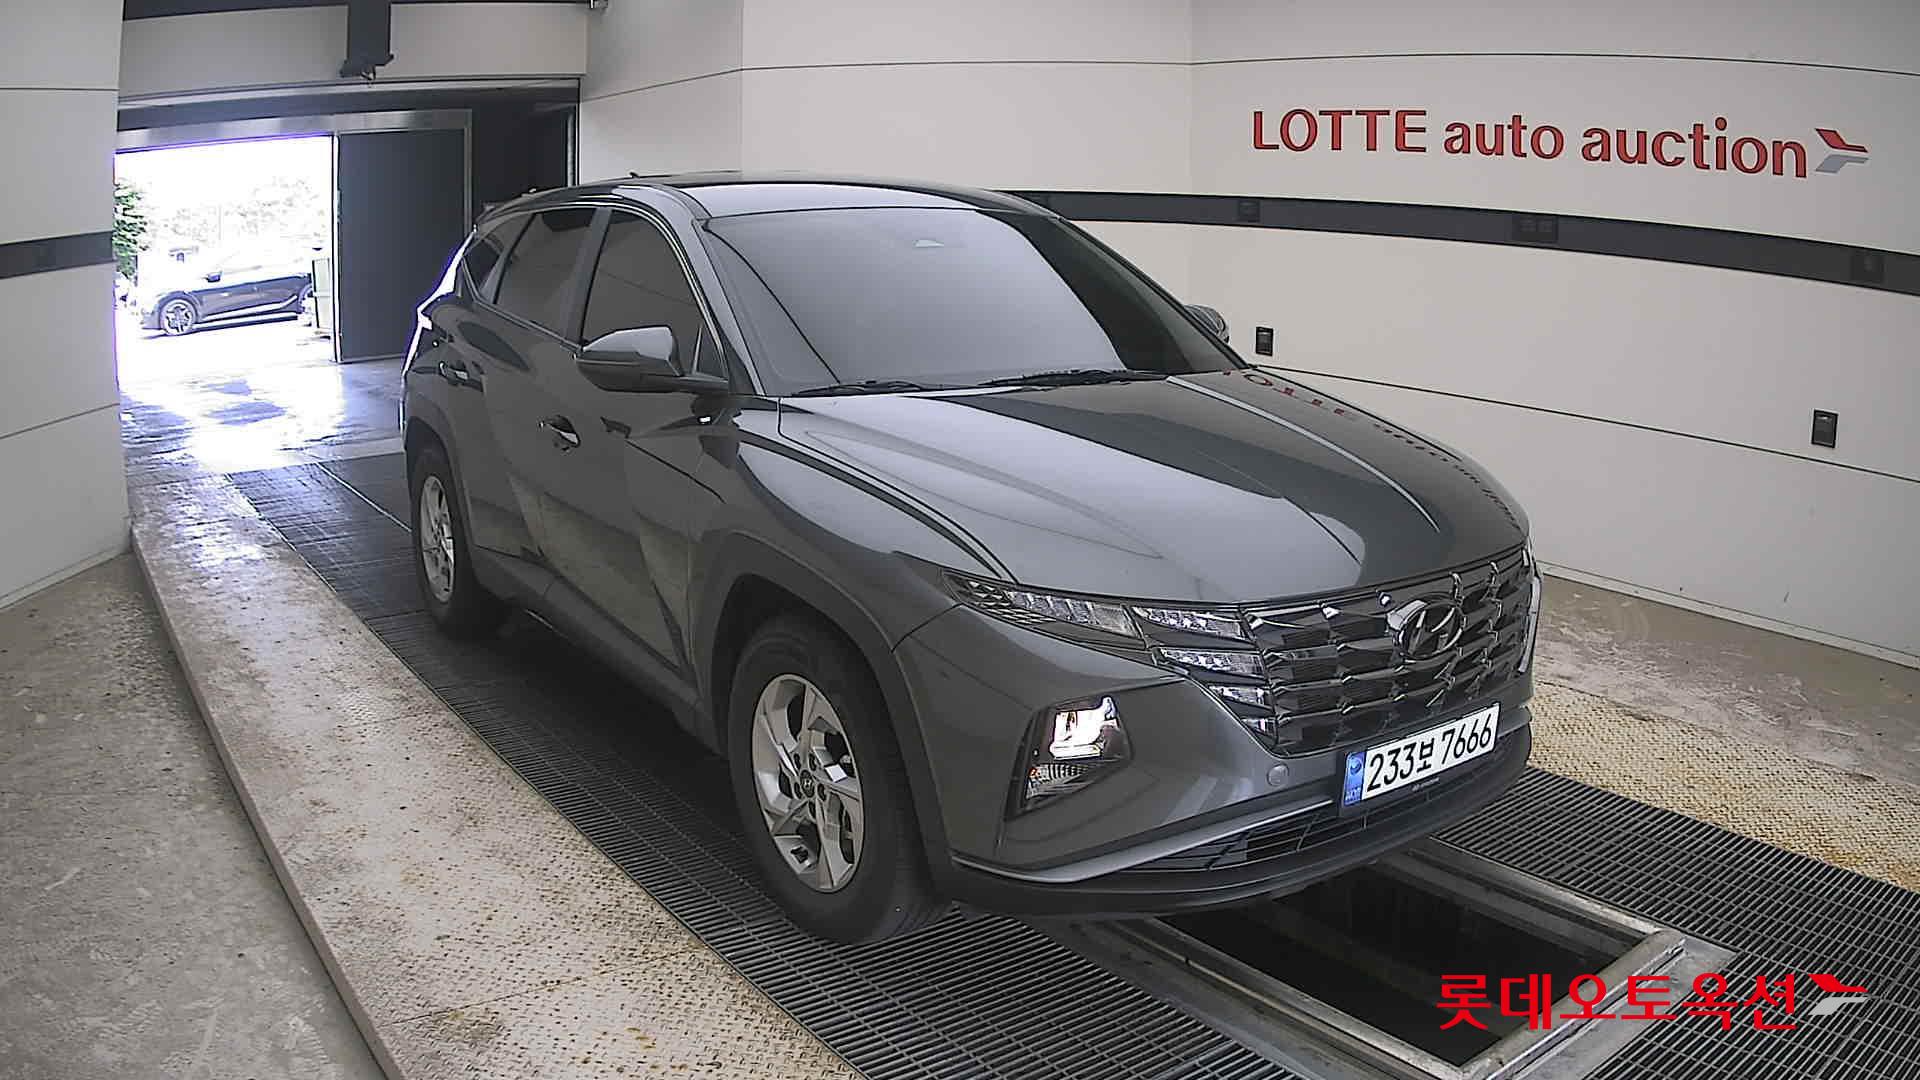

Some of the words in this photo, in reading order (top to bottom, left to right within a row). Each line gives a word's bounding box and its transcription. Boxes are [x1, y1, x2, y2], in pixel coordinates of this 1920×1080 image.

[1253, 109, 1426, 152] LOTTE
[1444, 115, 1564, 159] auto
[1581, 117, 1807, 178] auction
[1366, 737, 1435, 792] 233보
[1441, 713, 1492, 765] 7666
